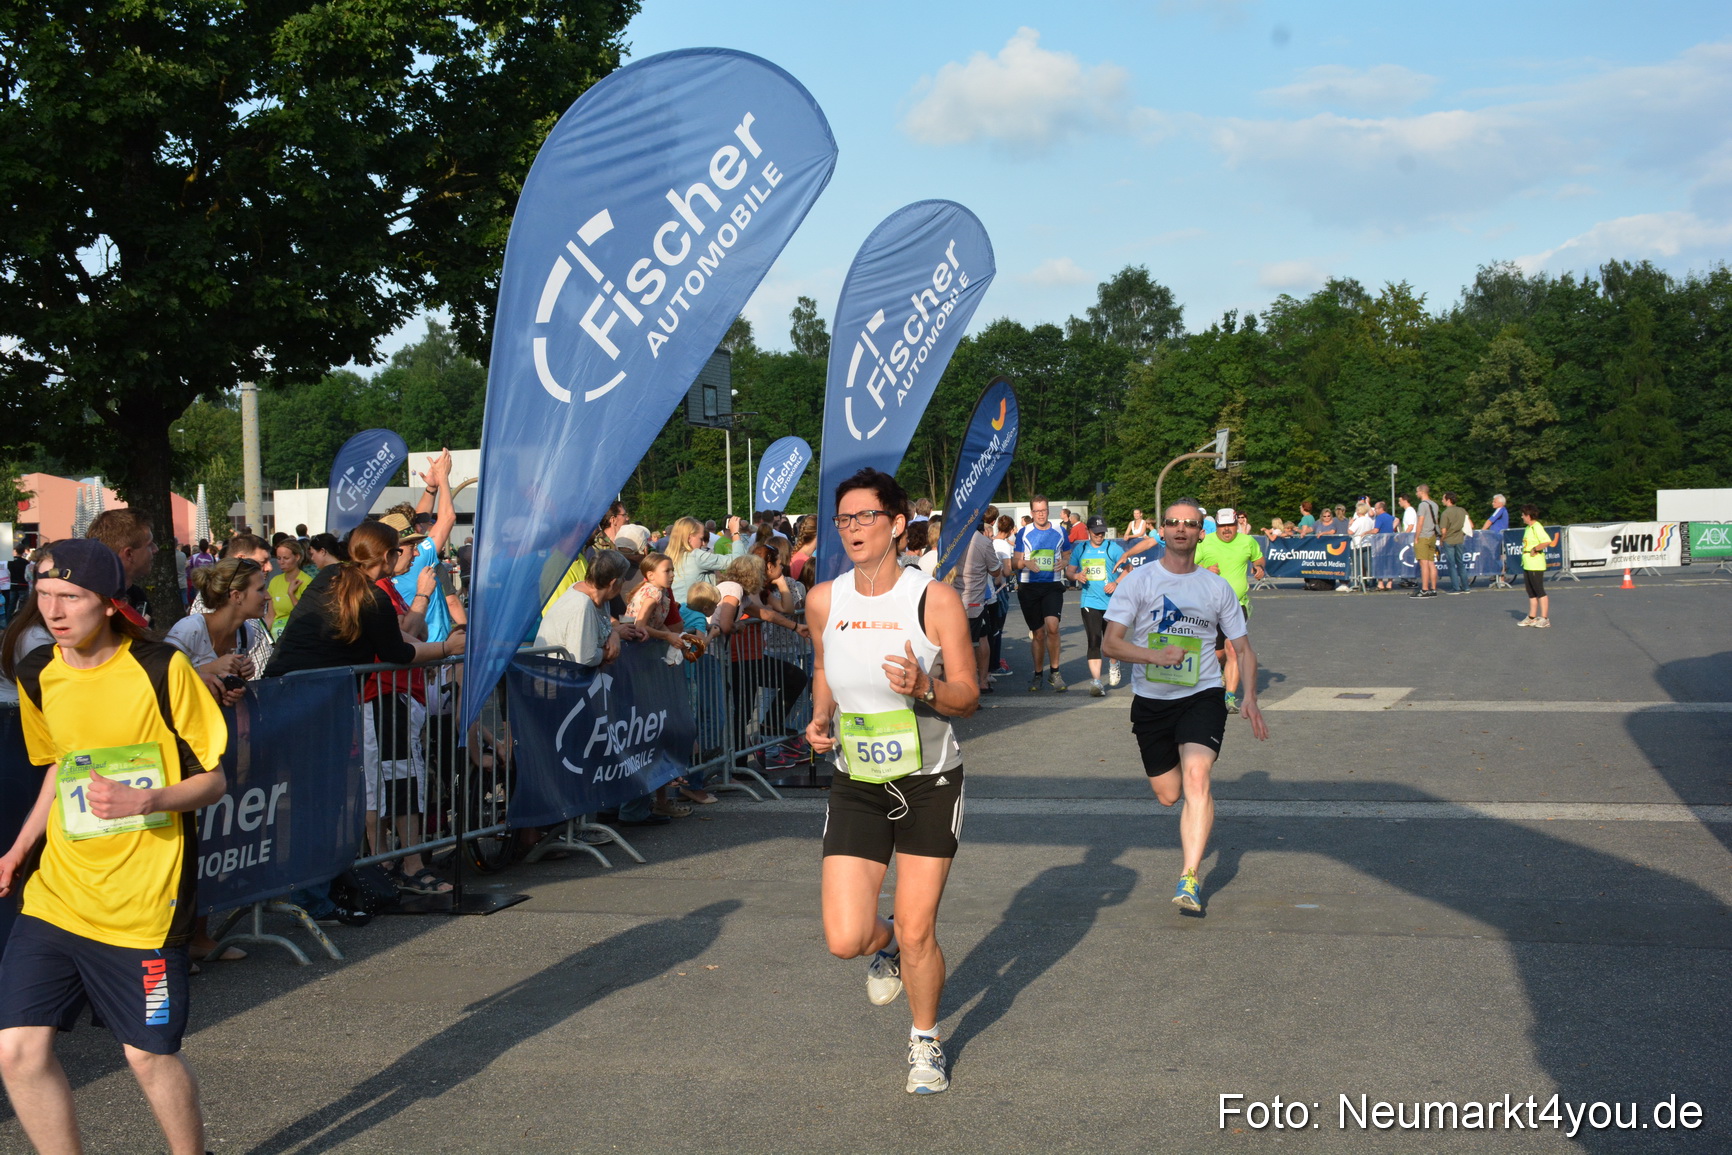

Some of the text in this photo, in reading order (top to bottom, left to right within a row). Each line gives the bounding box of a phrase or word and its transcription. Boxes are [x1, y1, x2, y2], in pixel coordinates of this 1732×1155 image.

[579, 111, 763, 361] Fischer
[646, 161, 784, 359] AUTOMOBILE
[866, 239, 960, 411] Fischer
[896, 271, 970, 407] AUTOMOBILE
[346, 442, 391, 501] Fischer
[361, 453, 396, 501] AUTOMOBILE
[770, 447, 800, 495] Fischer
[780, 455, 803, 494] AUTOMOBILE
[953, 433, 1001, 510] Frischmann
[1268, 548, 1327, 561] Frischmann
[1611, 533, 1653, 554] swn
[1696, 527, 1732, 545] AOK
[851, 620, 904, 631] KLEBL
[583, 706, 668, 759] Fischer
[857, 740, 903, 765] 569
[592, 747, 656, 784] AUTOMOBILE
[141, 958, 170, 1026] PUMA
